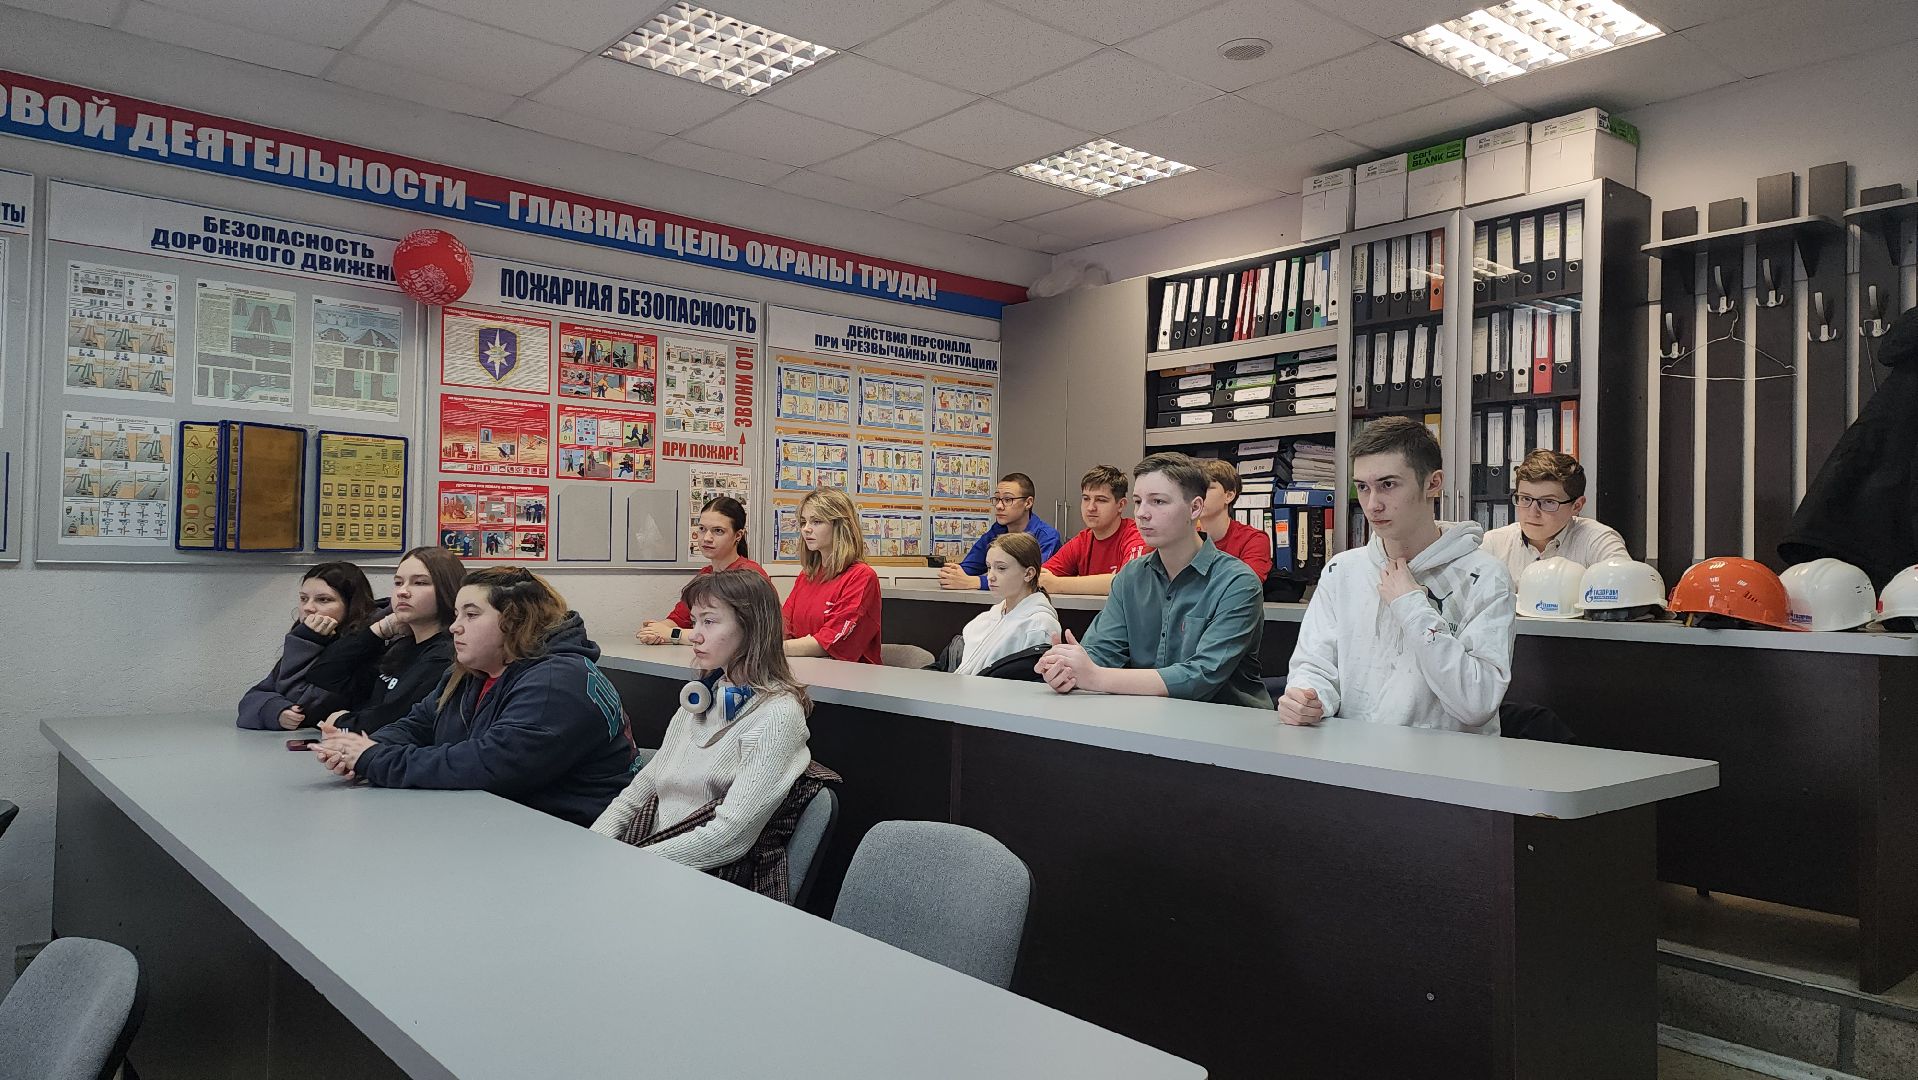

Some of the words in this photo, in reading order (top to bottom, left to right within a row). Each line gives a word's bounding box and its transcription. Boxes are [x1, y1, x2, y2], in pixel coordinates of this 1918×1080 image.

[1411, 152, 1444, 167] BLANK
[0, 83, 117, 141] ВОЙ
[128, 114, 468, 211] ДЕЯТЕЛЬНОСТИ
[508, 190, 656, 248] ГЛАВНАЯ
[663, 223, 739, 262] ЦЕЛЬ
[746, 239, 853, 284] ОХРАНЫ
[857, 263, 938, 301] ТРУДА!
[150, 228, 296, 266] ДОРОЖНОГО
[203, 215, 375, 259] БЕЗОПАСНОСТЬ
[500, 267, 613, 312] ПОЖАРНАЯ
[616, 286, 757, 333] БЕЗОПАСНОСТЬ
[815, 334, 838, 349] ПРИ
[841, 337, 938, 363] ЧРЕЗВЫЧАЙНЫХ
[940, 352, 998, 372] СИТУАЦИЯХ
[847, 323, 907, 346] ДЕЙСТВИЯ
[910, 332, 972, 354] ПЕРСОНАЛА
[733, 374, 753, 428] ЗВОНИ
[662, 441, 687, 457] ПРИ
[689, 443, 739, 461] ПОЖАРЕ
